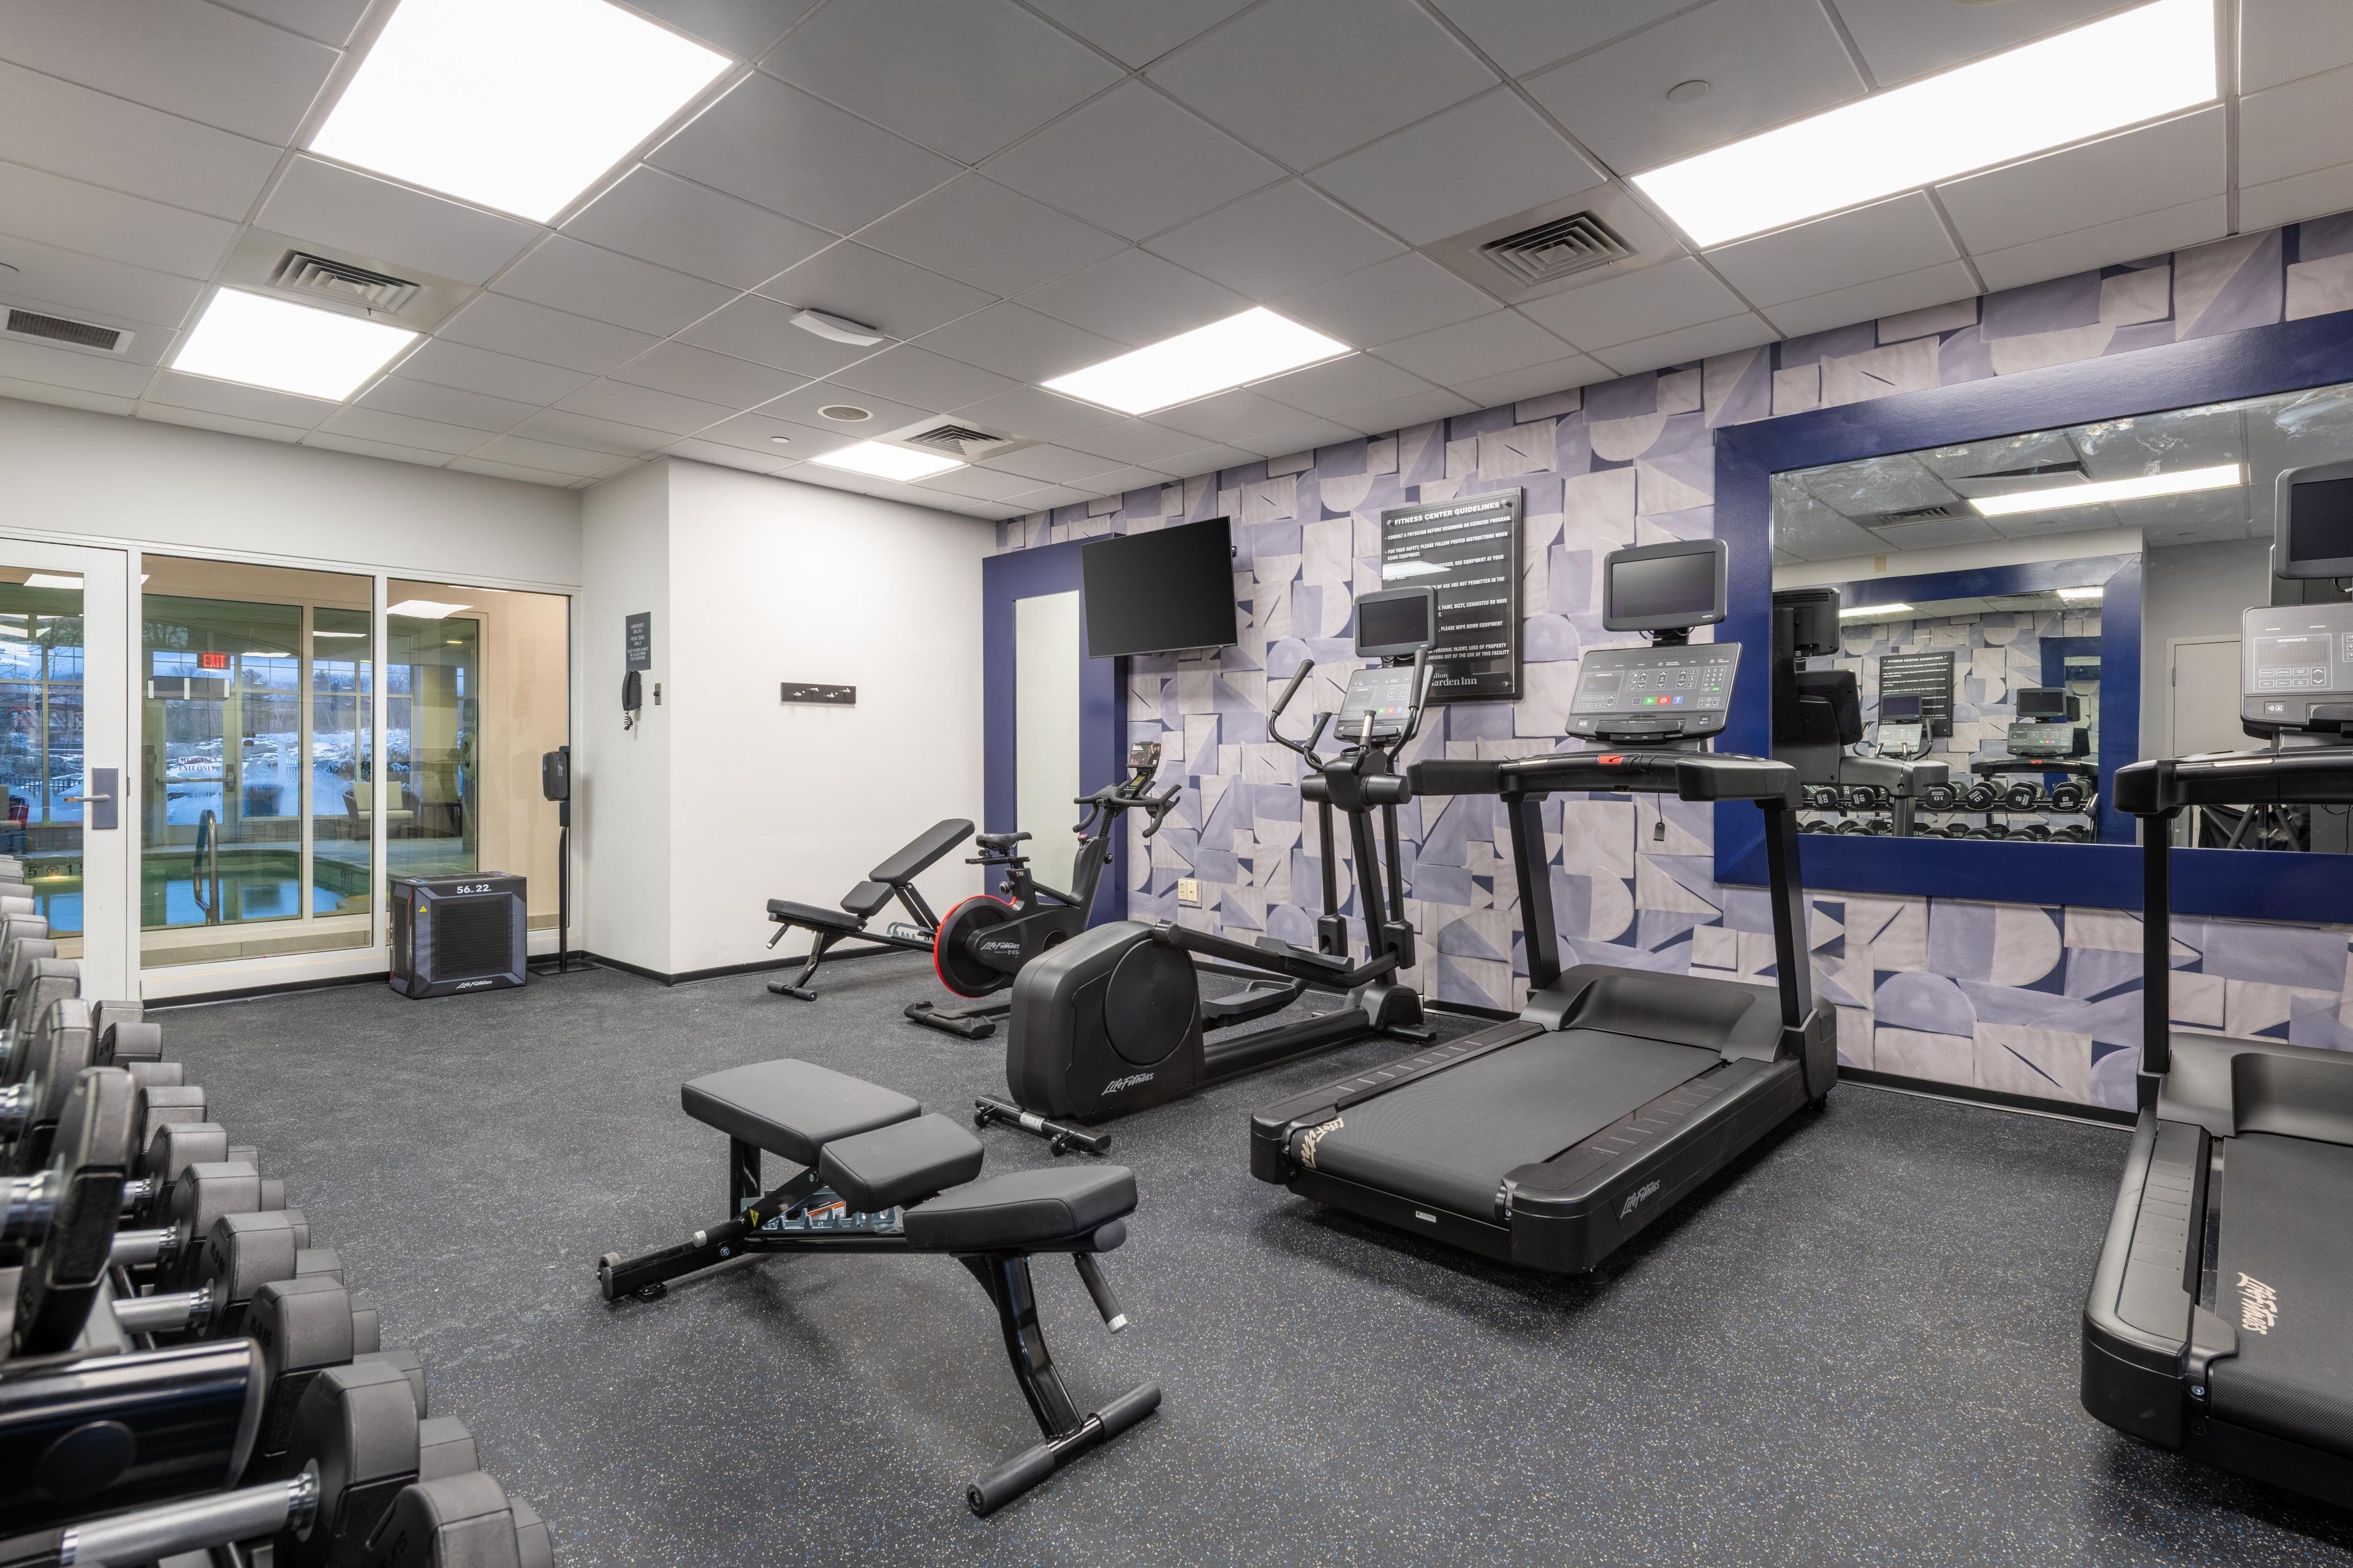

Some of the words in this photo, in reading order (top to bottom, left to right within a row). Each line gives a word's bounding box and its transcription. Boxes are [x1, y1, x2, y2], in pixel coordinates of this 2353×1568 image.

[1395, 515, 1423, 526] FITNESS
[1425, 510, 1453, 520] CENTER
[1455, 502, 1499, 515] GUIDELINES
[1466, 534, 1495, 542] INSTRUCTIONS
[203, 653, 226, 668] EXIT
[1461, 676, 1477, 685] Inn
